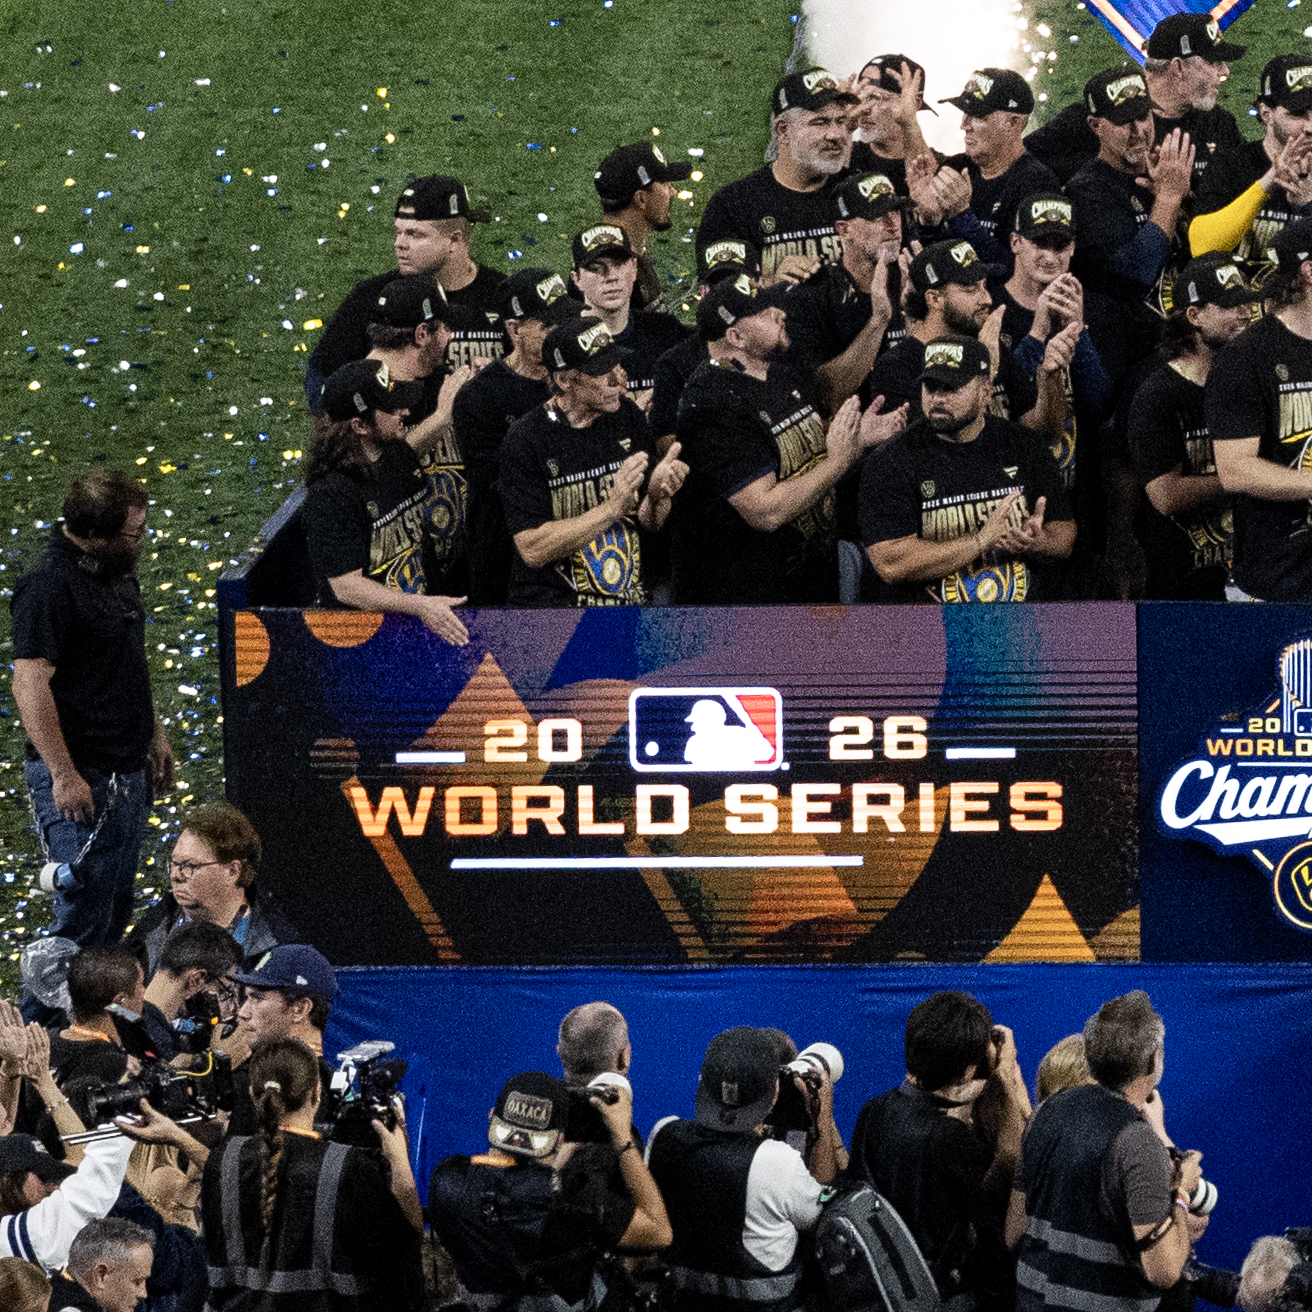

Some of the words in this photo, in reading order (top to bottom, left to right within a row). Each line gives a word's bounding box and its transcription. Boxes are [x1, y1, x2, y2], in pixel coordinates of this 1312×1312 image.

[481, 719, 583, 763] 20
[827, 716, 929, 761] 26
[1248, 717, 1281, 734] 20
[350, 783, 691, 838] WORLD
[724, 781, 1066, 834] SERIES
[507, 1099, 547, 1121] OAXACA
